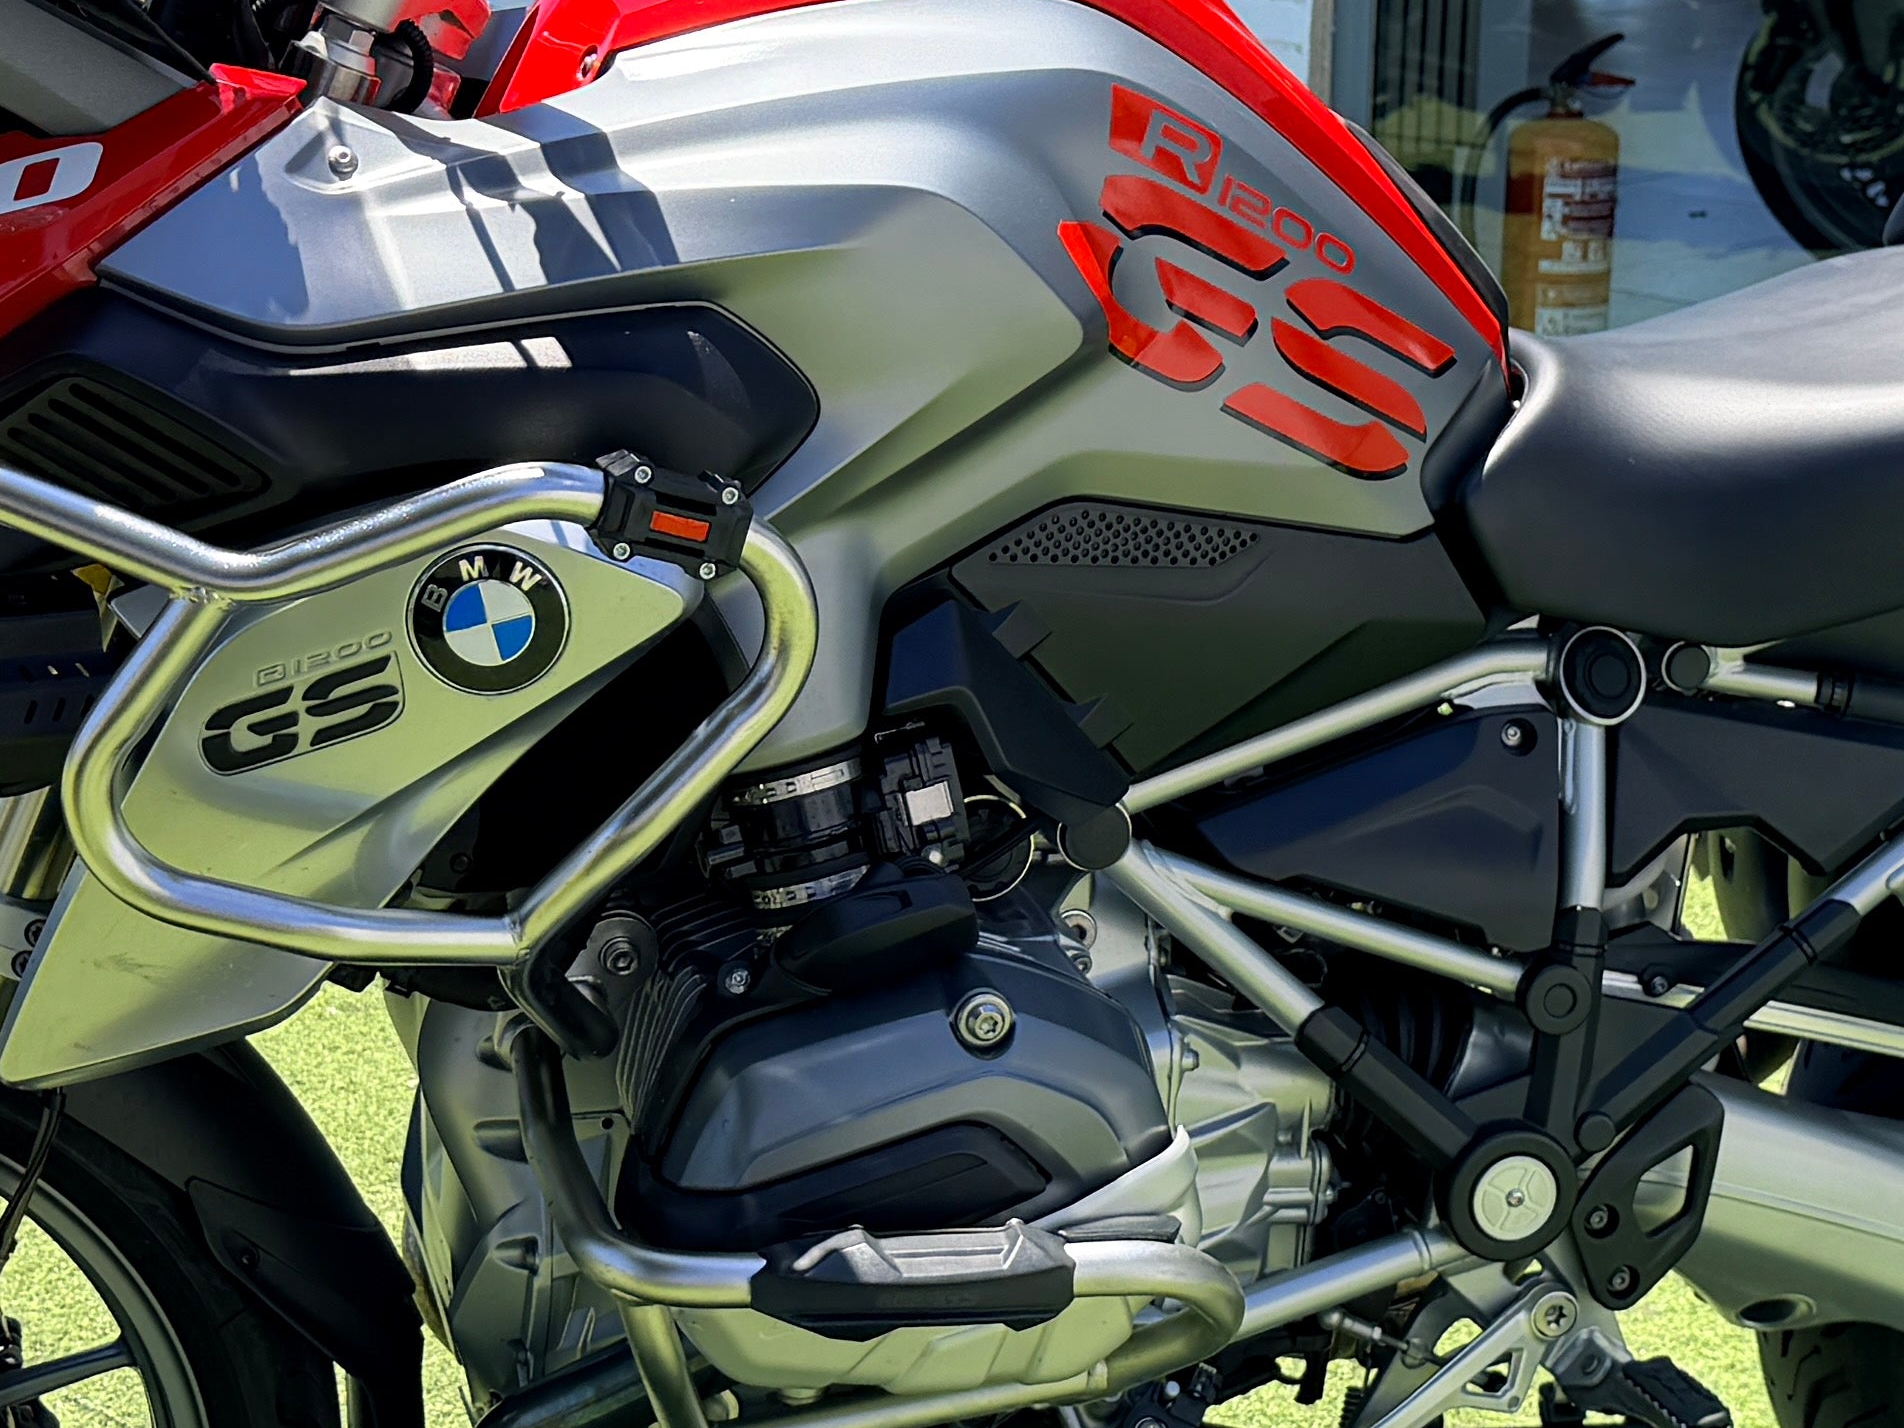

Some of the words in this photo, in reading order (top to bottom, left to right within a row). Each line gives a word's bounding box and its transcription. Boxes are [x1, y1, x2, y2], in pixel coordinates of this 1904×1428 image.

[1056, 174, 1456, 480] GS
[420, 555, 543, 613] BMW
[200, 655, 401, 773] GS
